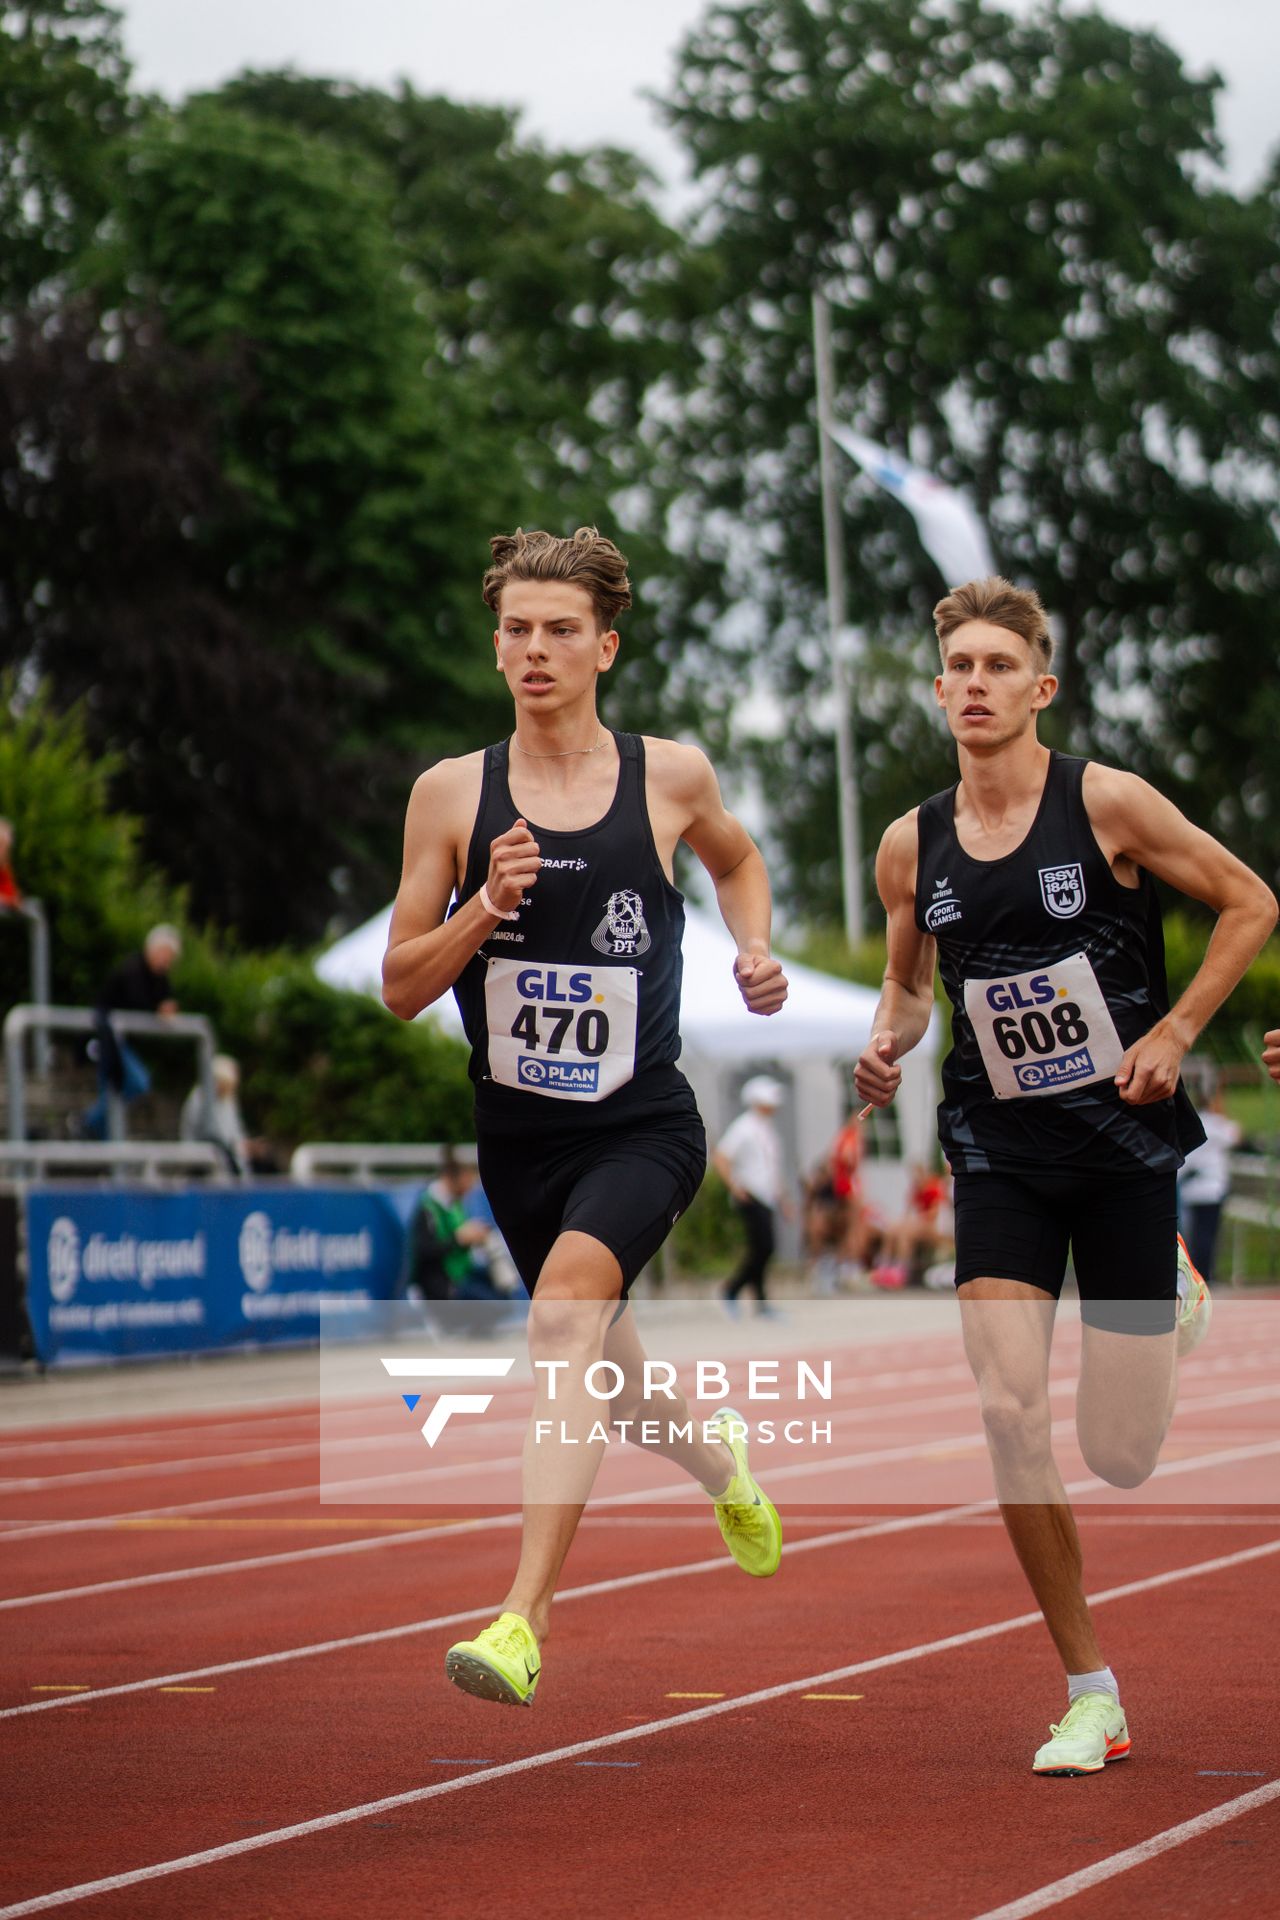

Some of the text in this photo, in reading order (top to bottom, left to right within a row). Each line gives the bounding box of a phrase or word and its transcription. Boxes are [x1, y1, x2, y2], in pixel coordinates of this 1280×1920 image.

[1044, 868, 1078, 883] SSV
[932, 888, 953, 900] erima
[1045, 879, 1079, 894] 1846
[933, 904, 955, 918] SPORT
[930, 911, 962, 927] KLAMSER
[613, 940, 636, 953] DT
[511, 1004, 610, 1057] 470
[992, 1002, 1089, 1060] 608
[1044, 1054, 1089, 1076] PLAN
[549, 1066, 595, 1082] PLAN
[1048, 1068, 1092, 1083] INTERNATIONAL
[549, 1080, 594, 1089] INTERNATIONAL
